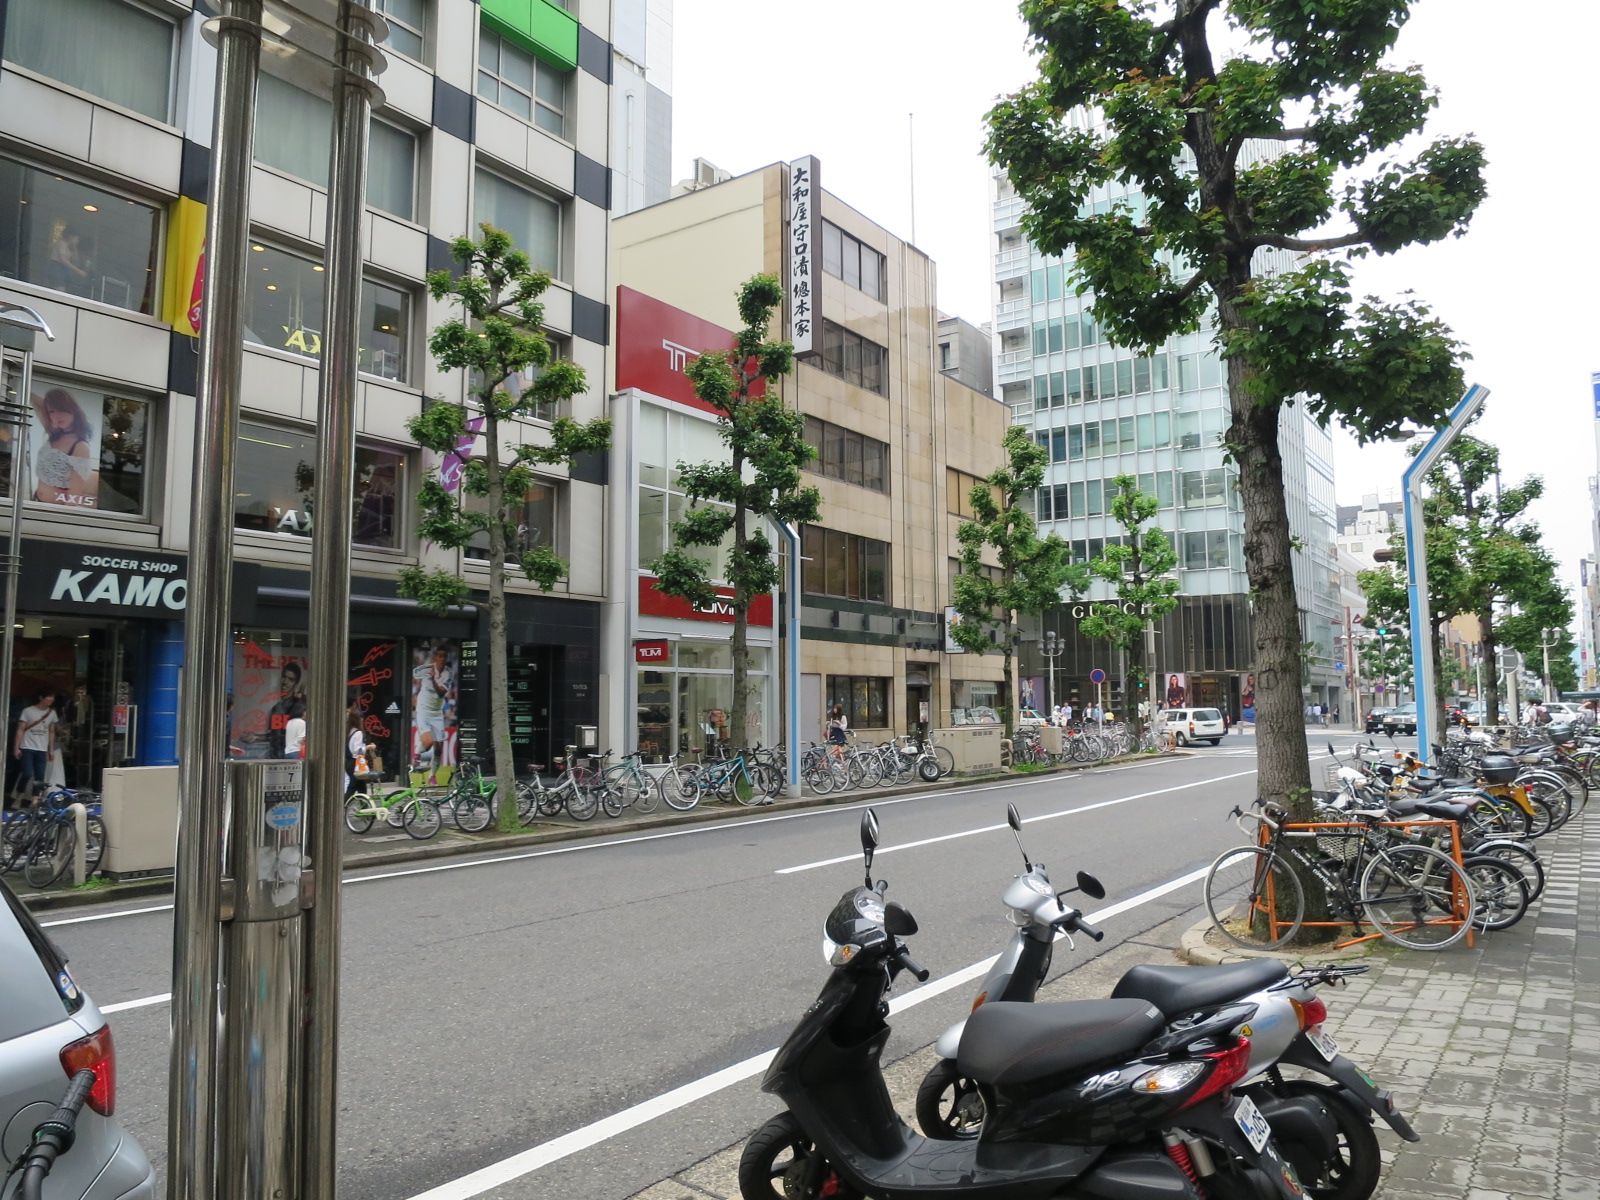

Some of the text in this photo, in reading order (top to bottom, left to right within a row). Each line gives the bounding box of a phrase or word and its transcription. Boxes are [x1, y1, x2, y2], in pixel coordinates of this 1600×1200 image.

[81, 555, 178, 574] SOCCER SHOP
[50, 568, 188, 610] KAMO
[1071, 602, 1146, 619] GUCI
[639, 647, 662, 657] TUMI
[287, 772, 295, 783] 7
